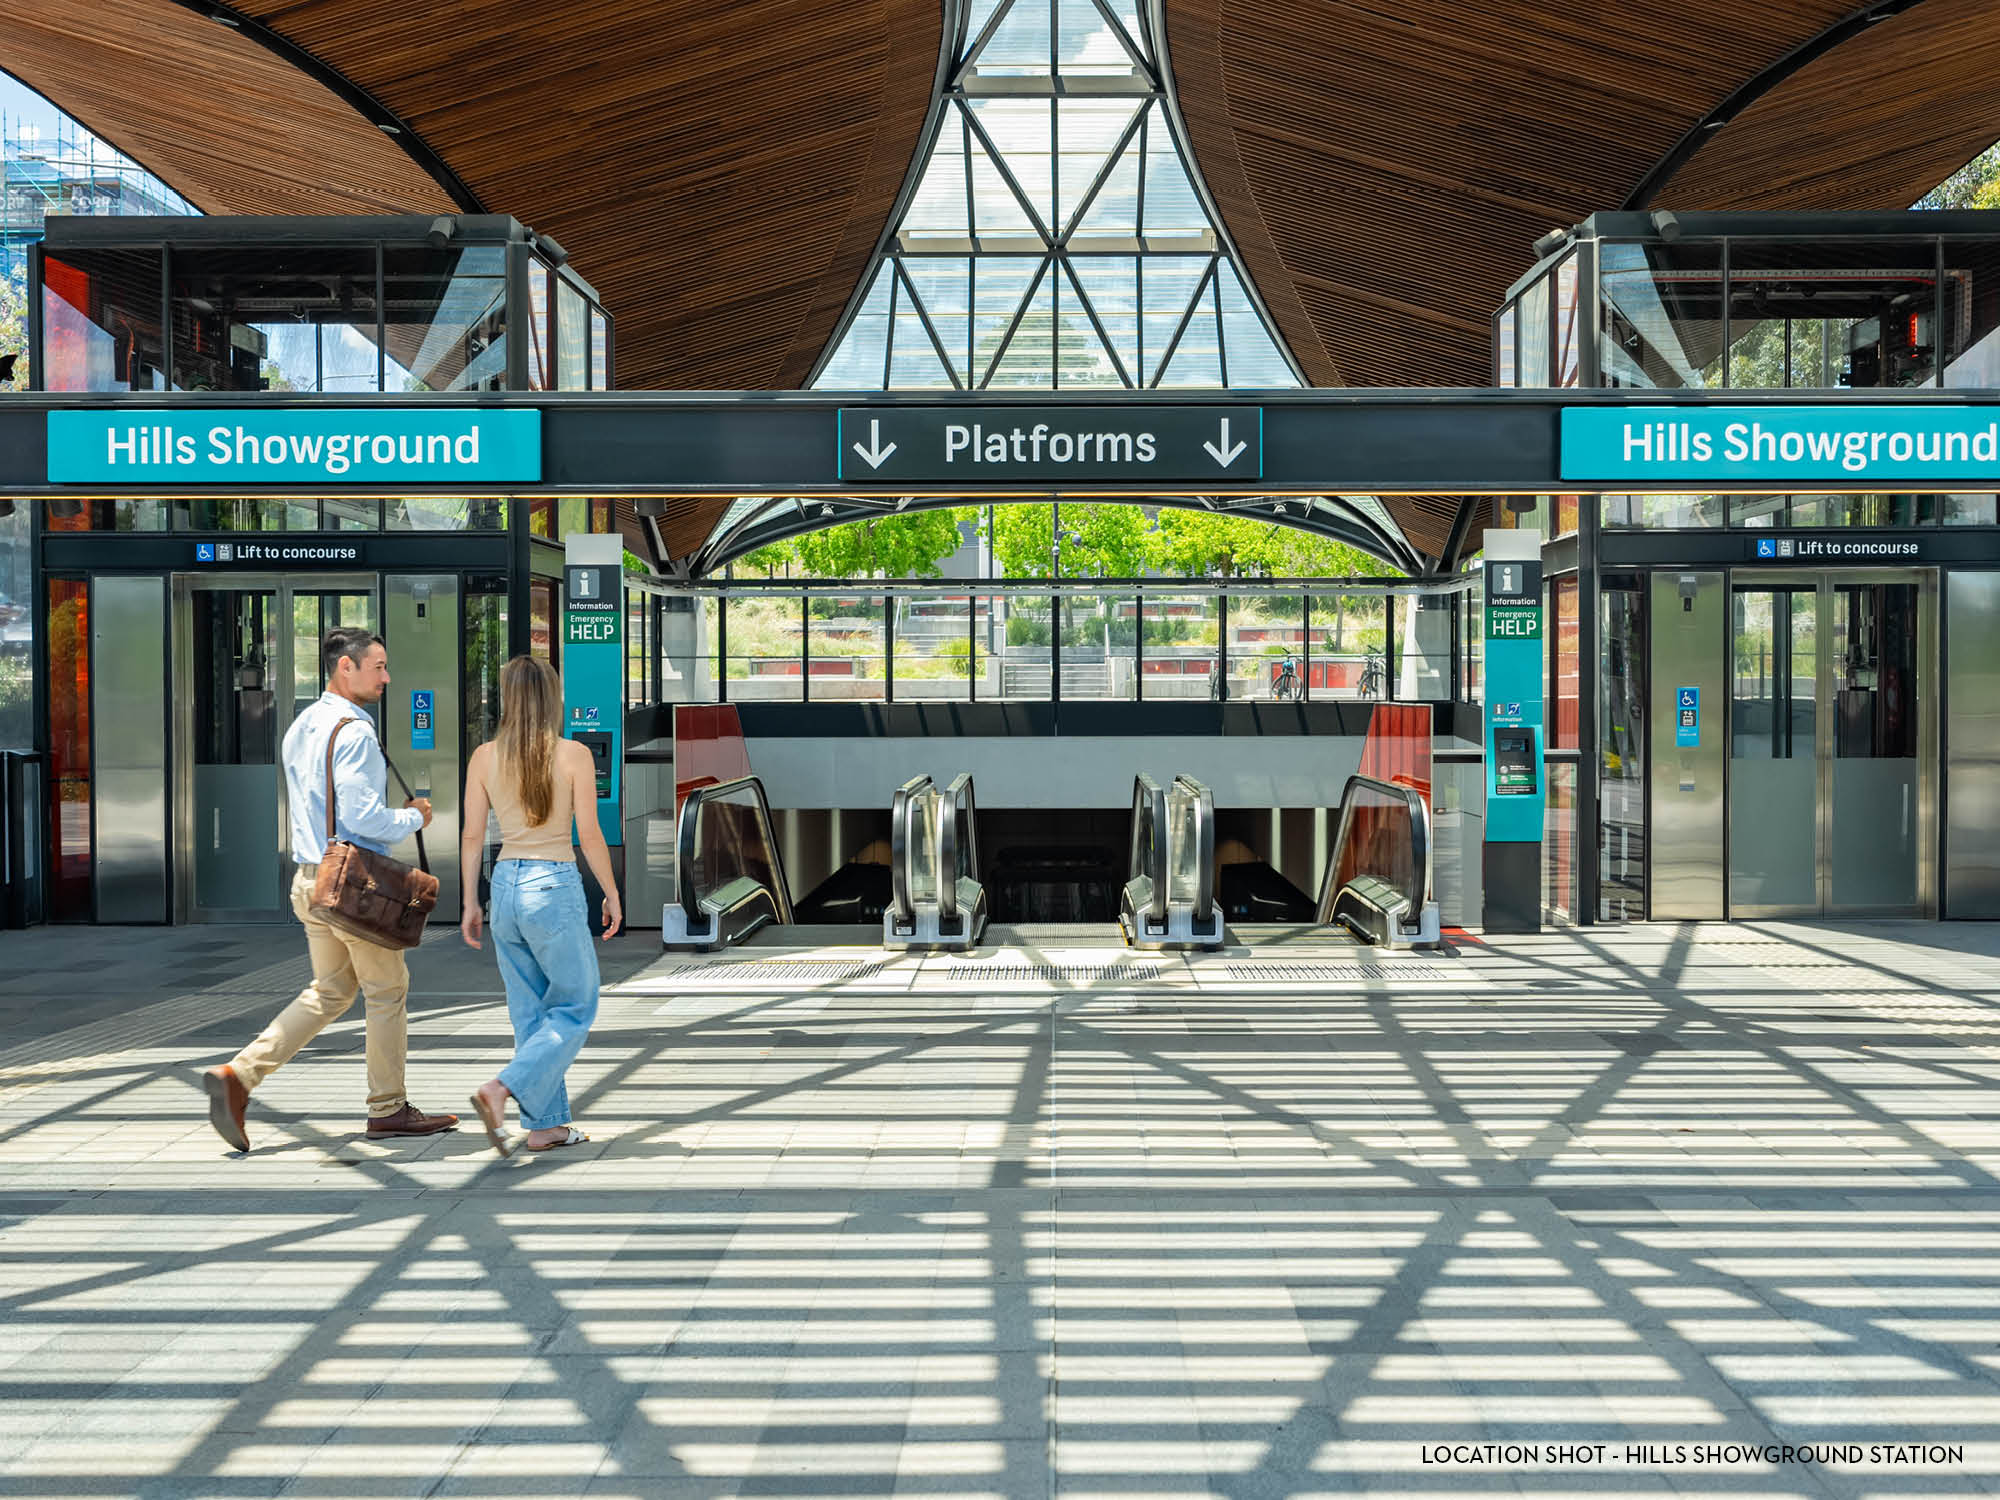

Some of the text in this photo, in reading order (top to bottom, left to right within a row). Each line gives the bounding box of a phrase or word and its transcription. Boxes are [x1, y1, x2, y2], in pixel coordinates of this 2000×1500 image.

[107, 426, 480, 474] Hills Showground
[945, 423, 1157, 463] Platforms
[1623, 422, 1998, 472] Hills Showground
[237, 545, 356, 559] Lift to concourse
[1798, 541, 1919, 555] Lift to concourse
[569, 602, 614, 610] Information
[1491, 598, 1537, 606] Information
[570, 614, 614, 624] Emergency
[1492, 610, 1537, 620] Emergency
[570, 624, 614, 640] HELP
[1492, 620, 1537, 636] HELP
